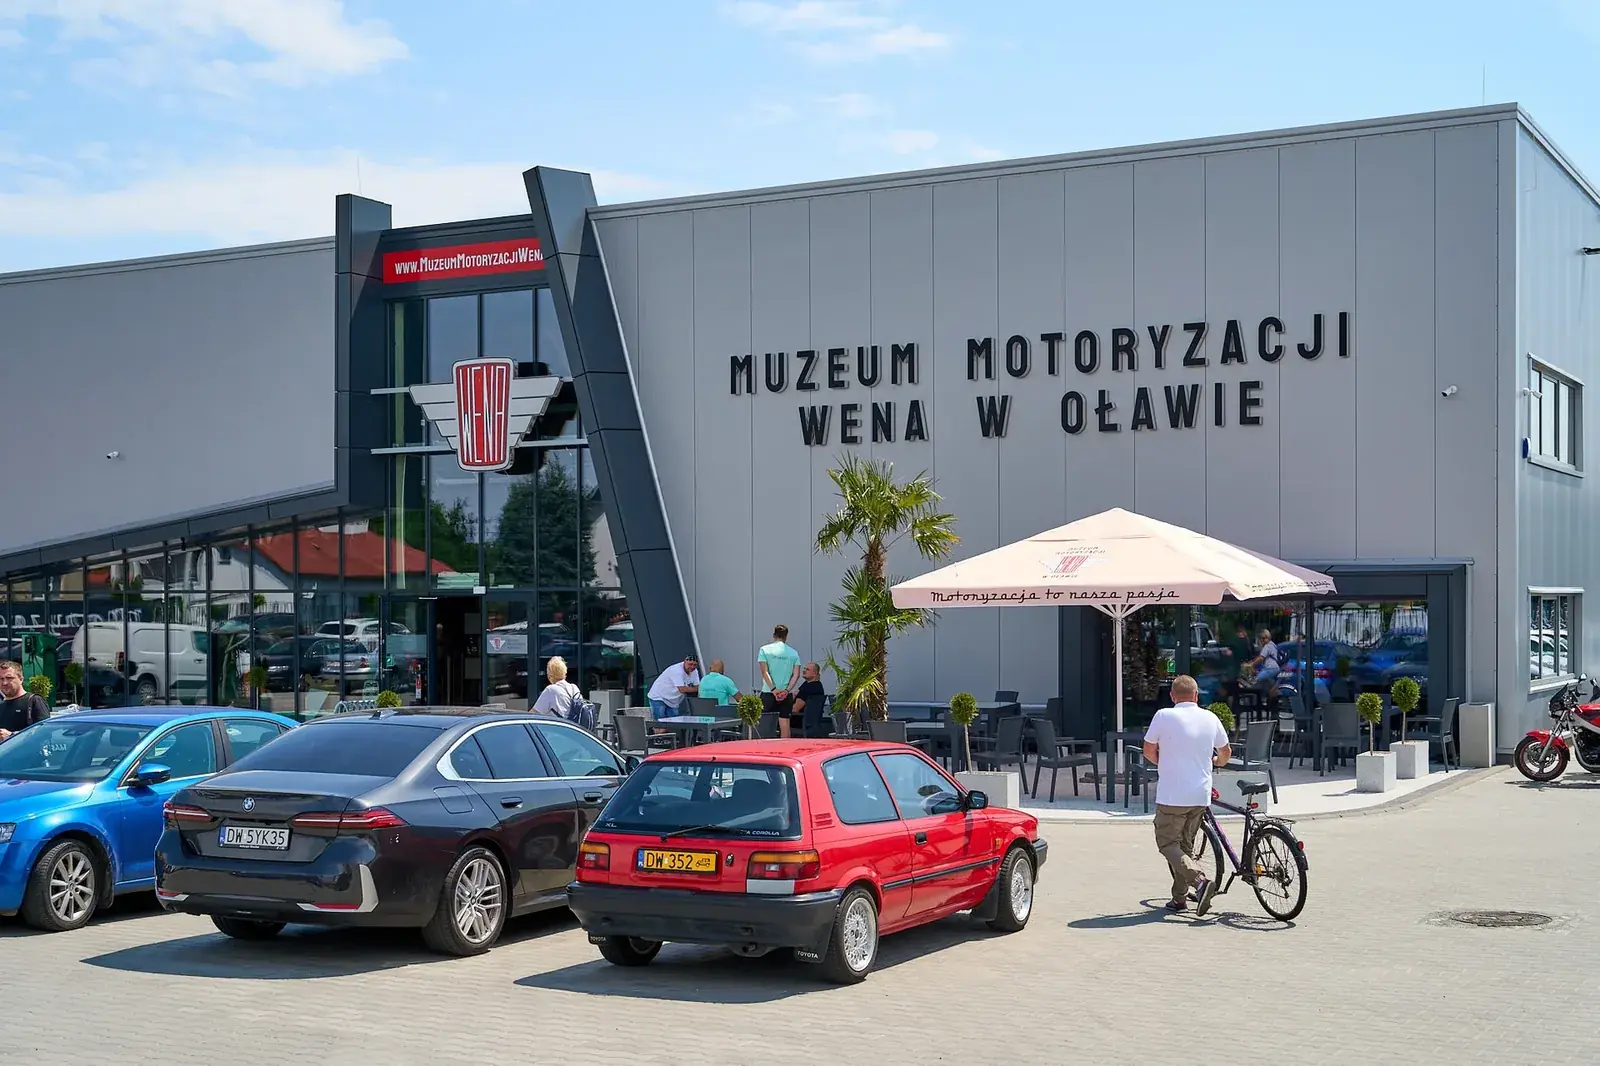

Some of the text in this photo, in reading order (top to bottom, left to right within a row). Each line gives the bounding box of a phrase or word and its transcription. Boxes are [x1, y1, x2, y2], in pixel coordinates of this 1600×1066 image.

[730, 311, 1348, 395] MUZEUM MOTORYZACJI
[460, 366, 506, 462] WENA
[798, 380, 1262, 446] WENA W OŁAWIE
[930, 588, 1180, 605] Motoryzacja to nasza pasja
[226, 828, 286, 845] DW 5YK35
[646, 852, 693, 870] DW 352
[797, 950, 819, 959] TOYOTA
